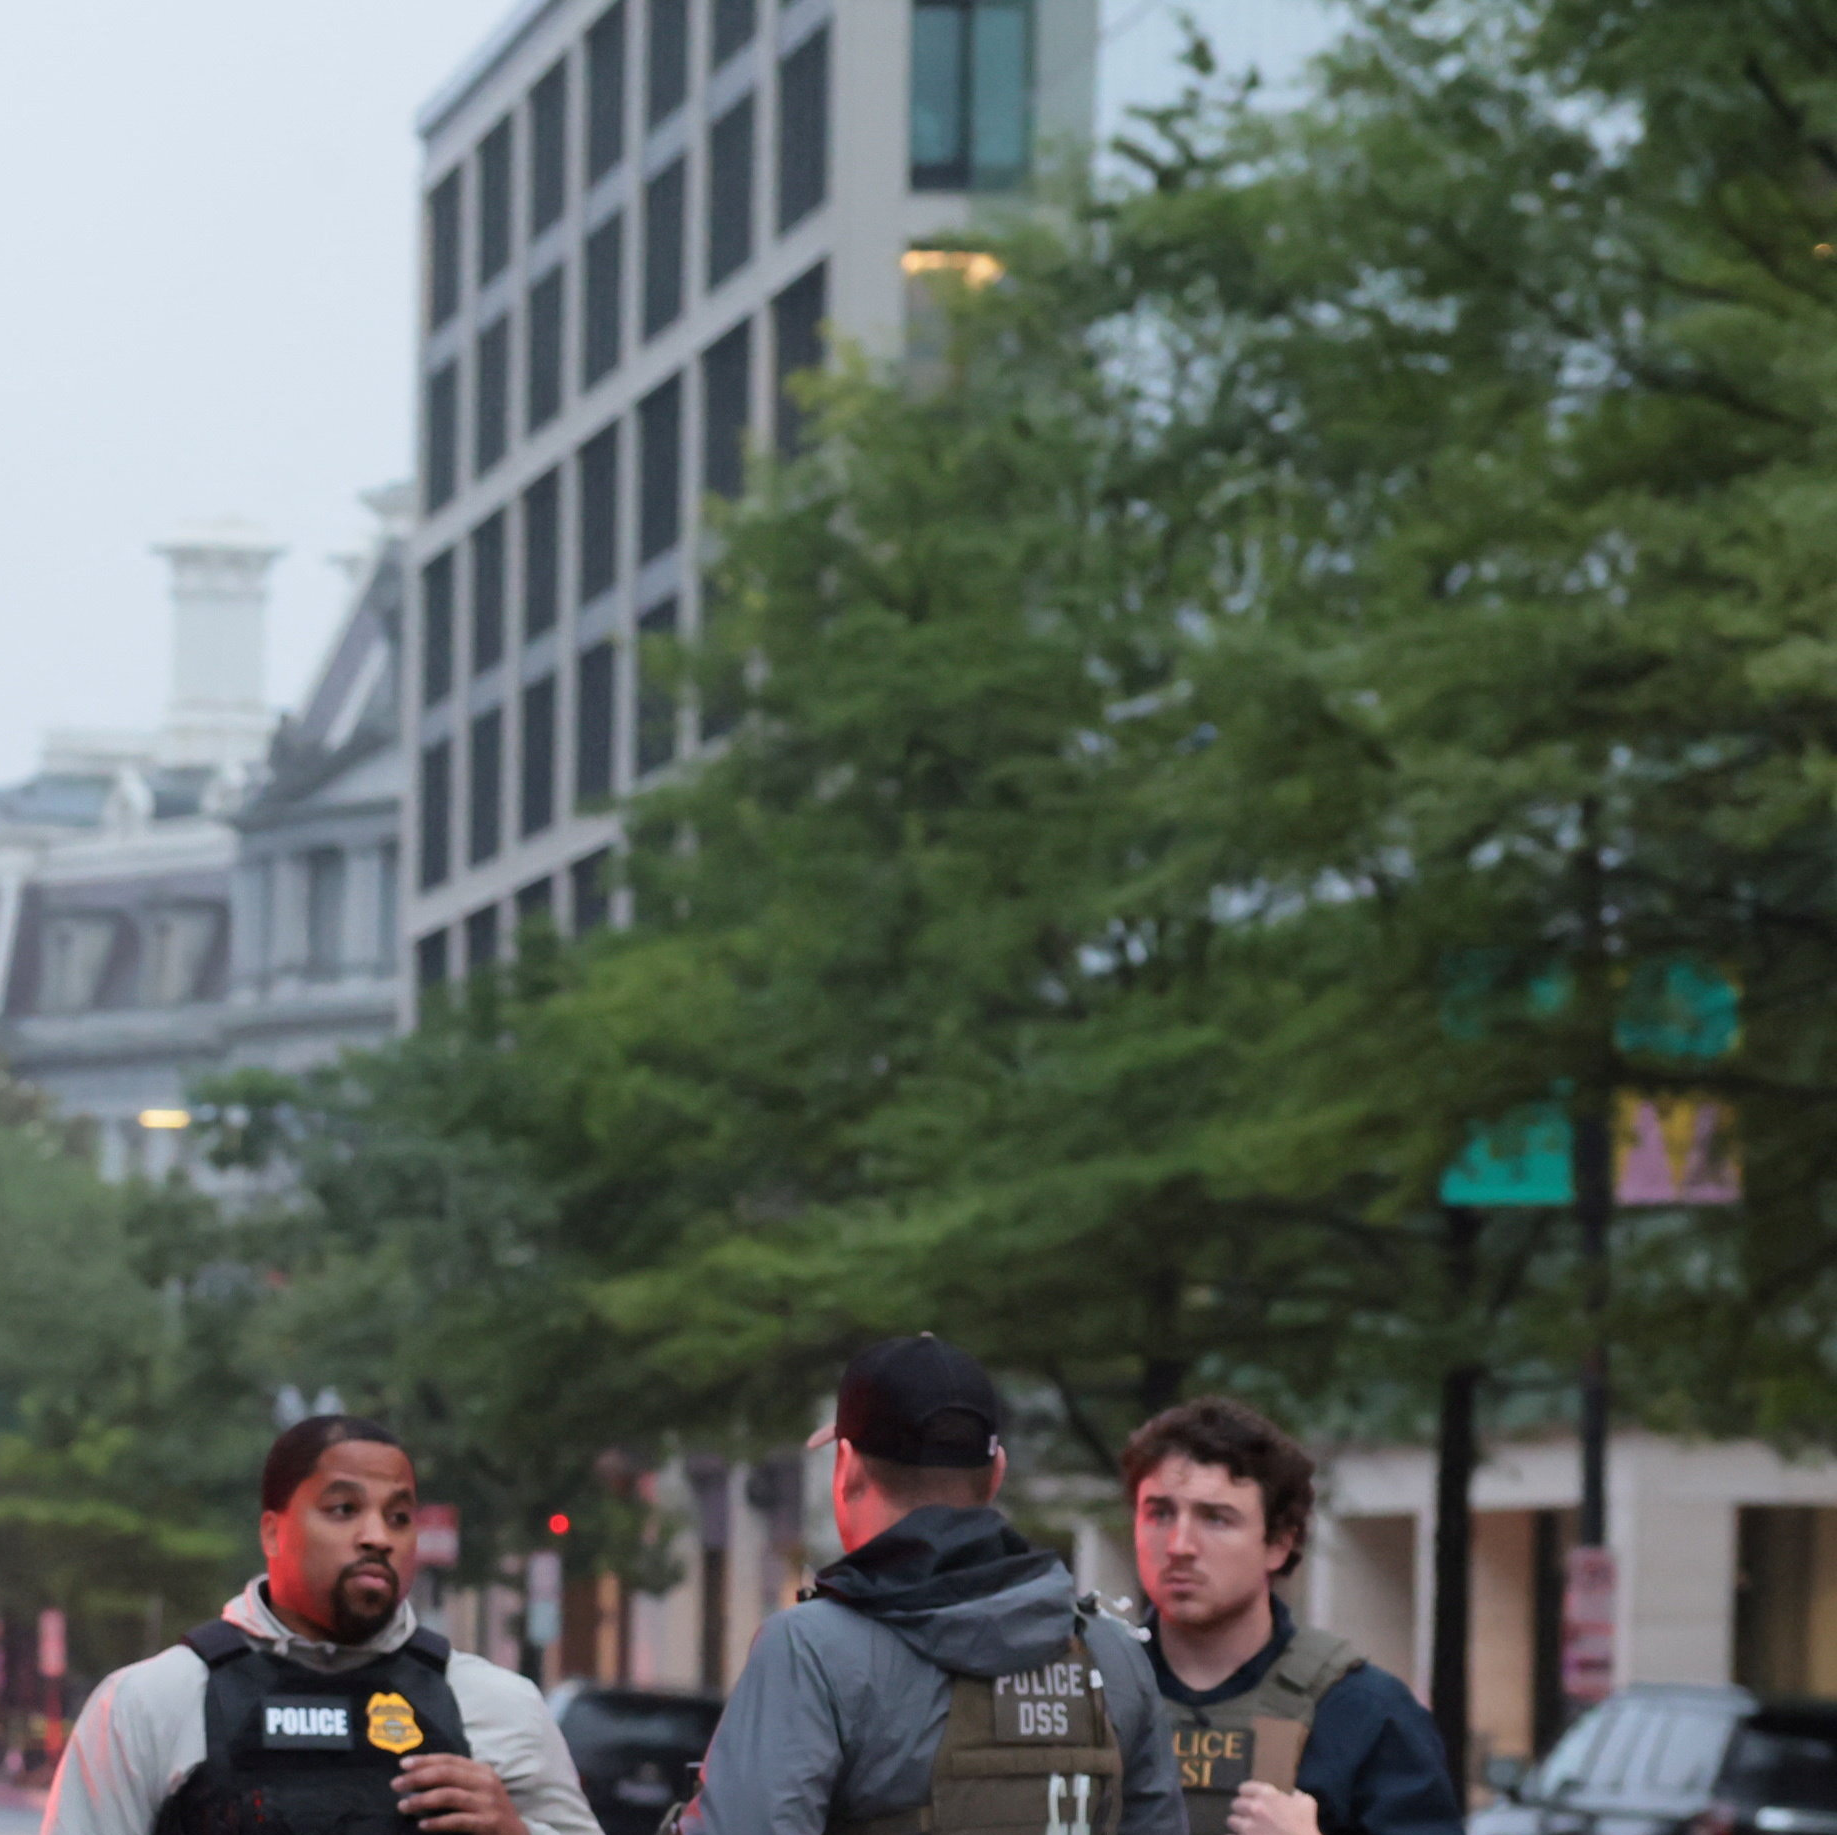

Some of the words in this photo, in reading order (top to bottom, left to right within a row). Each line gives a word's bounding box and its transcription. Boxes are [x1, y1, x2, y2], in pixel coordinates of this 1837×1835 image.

[265, 1706, 349, 1736] POLICE
[1019, 1702, 1069, 1736] DSS
[1173, 1730, 1244, 1759] LICE
[1182, 1759, 1213, 1788] SI
